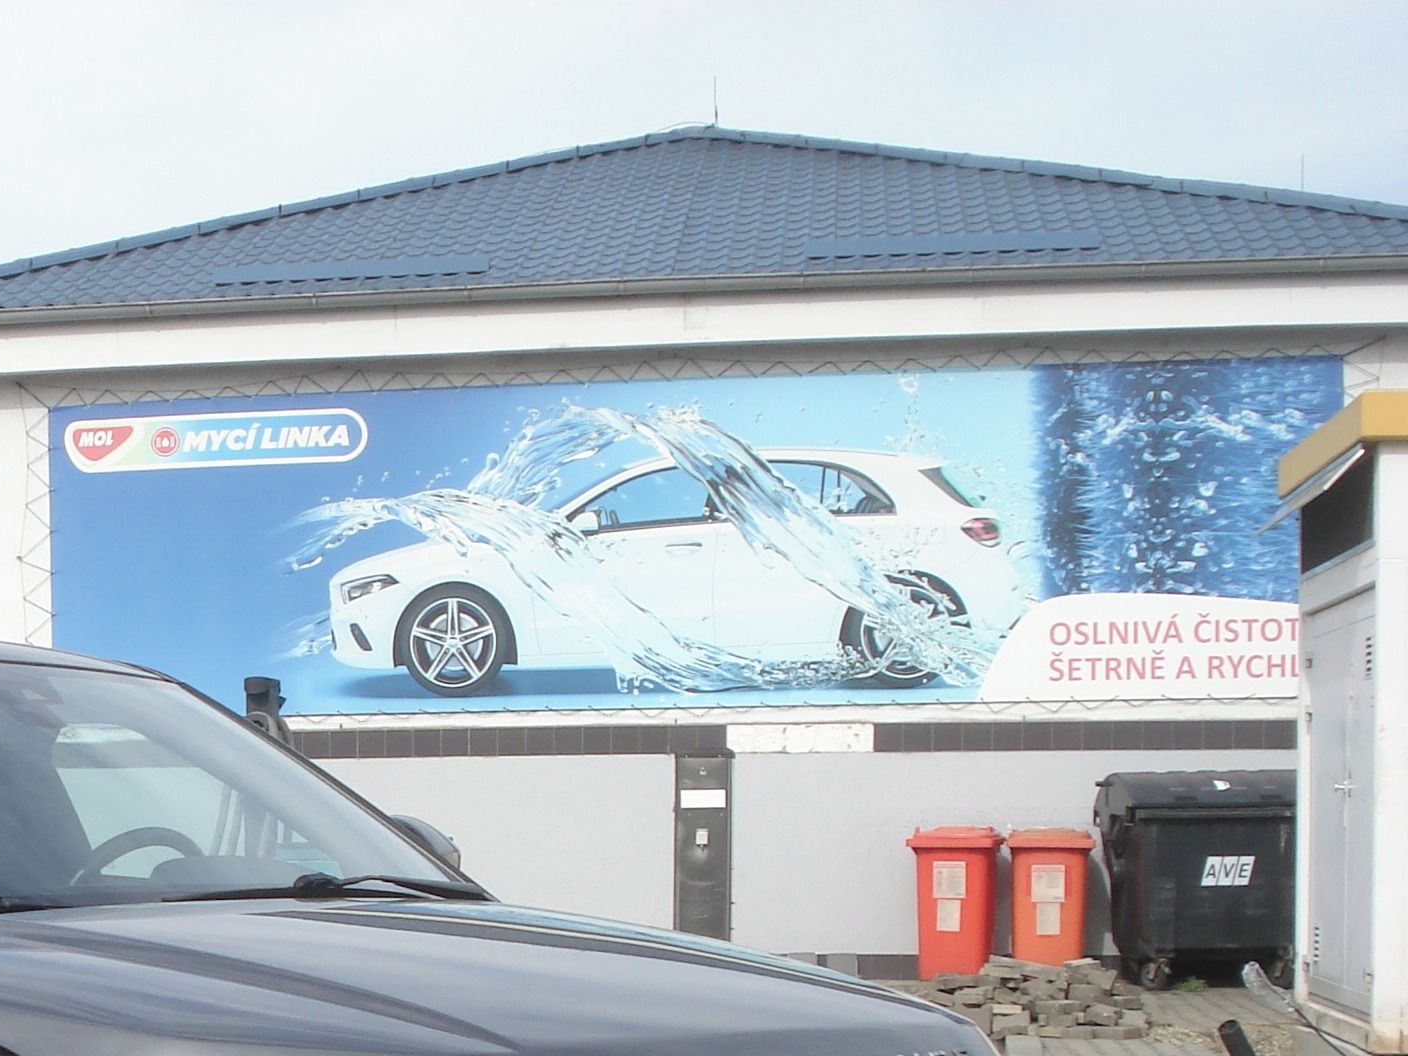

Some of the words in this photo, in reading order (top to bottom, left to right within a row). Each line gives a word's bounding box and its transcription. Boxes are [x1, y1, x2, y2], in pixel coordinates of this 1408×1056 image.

[78, 431, 114, 448] MOL
[182, 422, 258, 453] MYCÍ
[260, 424, 350, 450] LINKA
[1049, 613, 1184, 646] OSLNIVÁ
[1048, 650, 1166, 682] ŠETRNĚ
[1175, 656, 1197, 680] A
[1204, 863, 1251, 879] AVE
